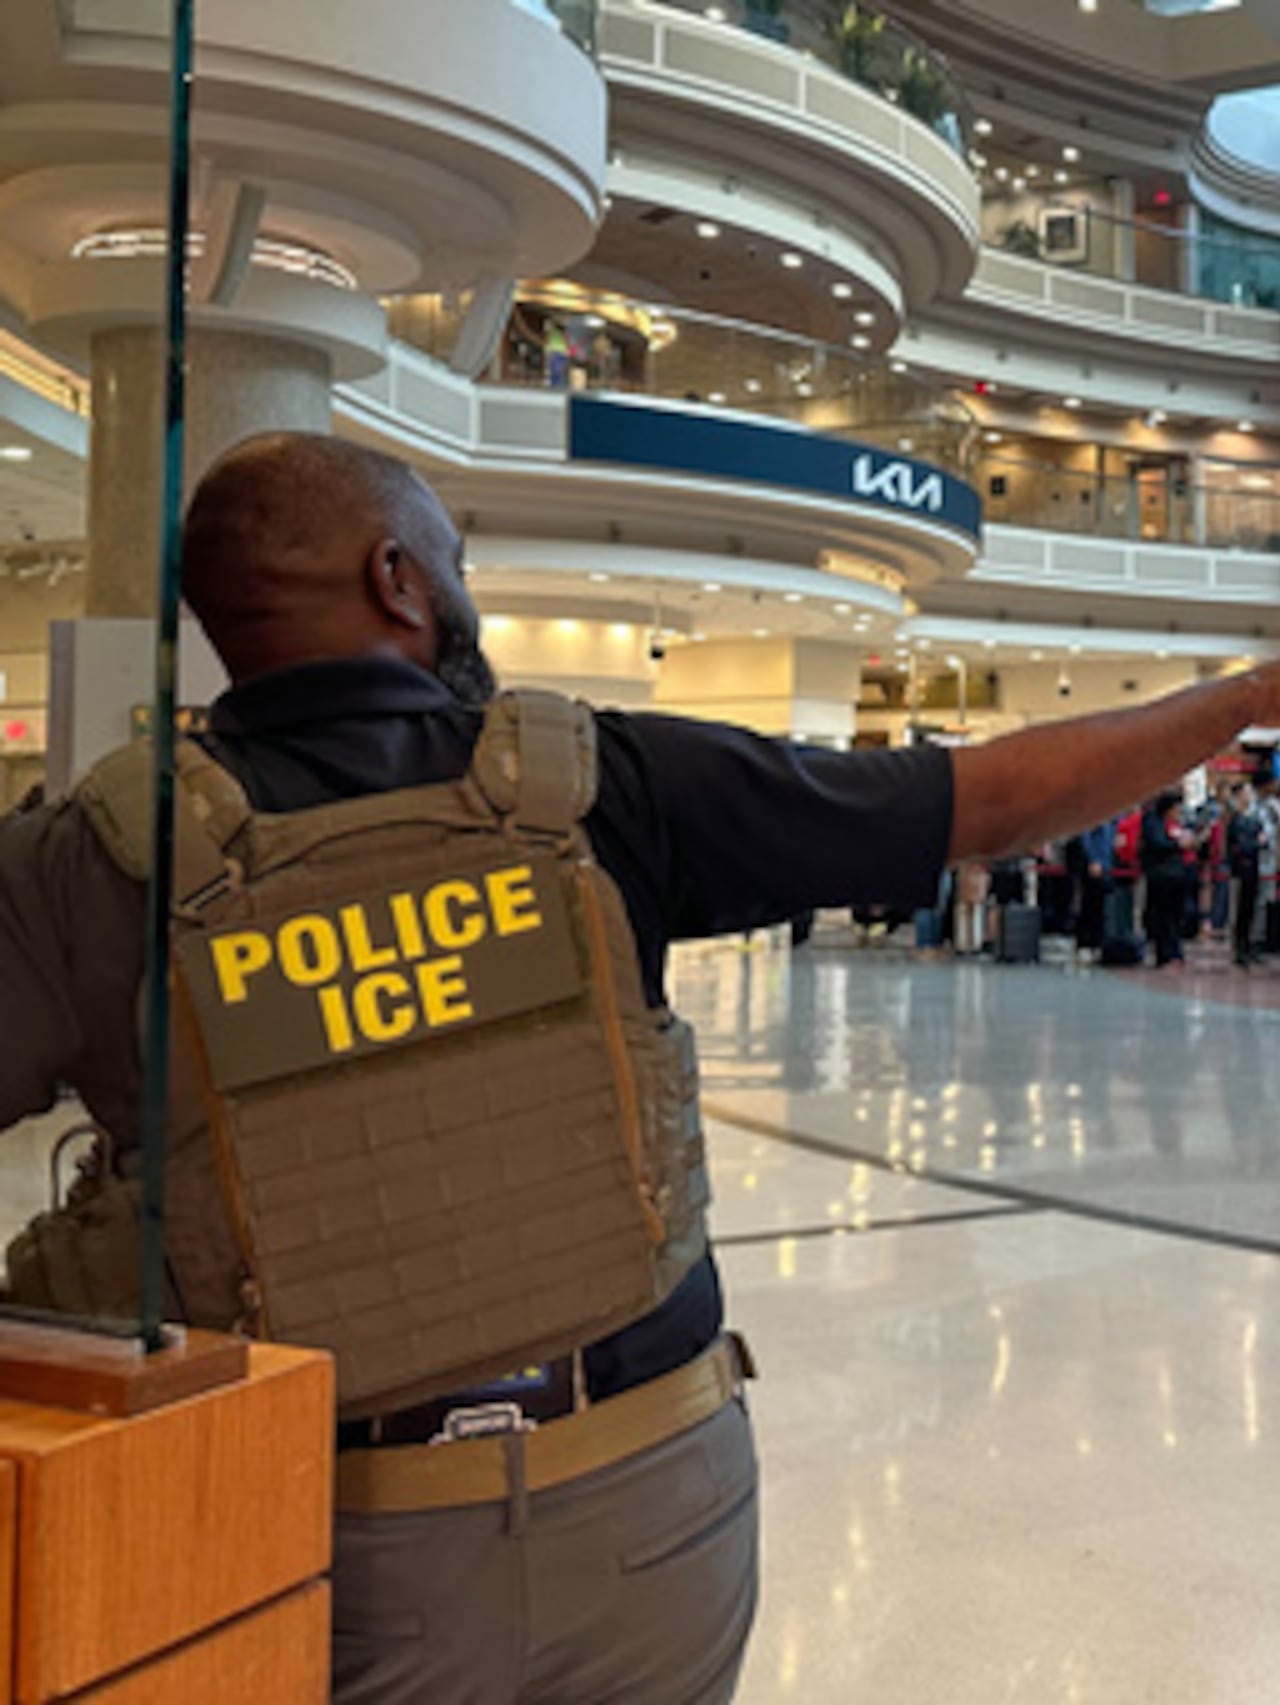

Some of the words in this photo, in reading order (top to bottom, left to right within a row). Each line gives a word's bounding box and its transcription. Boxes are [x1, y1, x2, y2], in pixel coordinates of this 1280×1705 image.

[853, 453, 943, 512] KIA
[210, 865, 542, 1004] POLICE
[318, 954, 473, 1052] ICE
